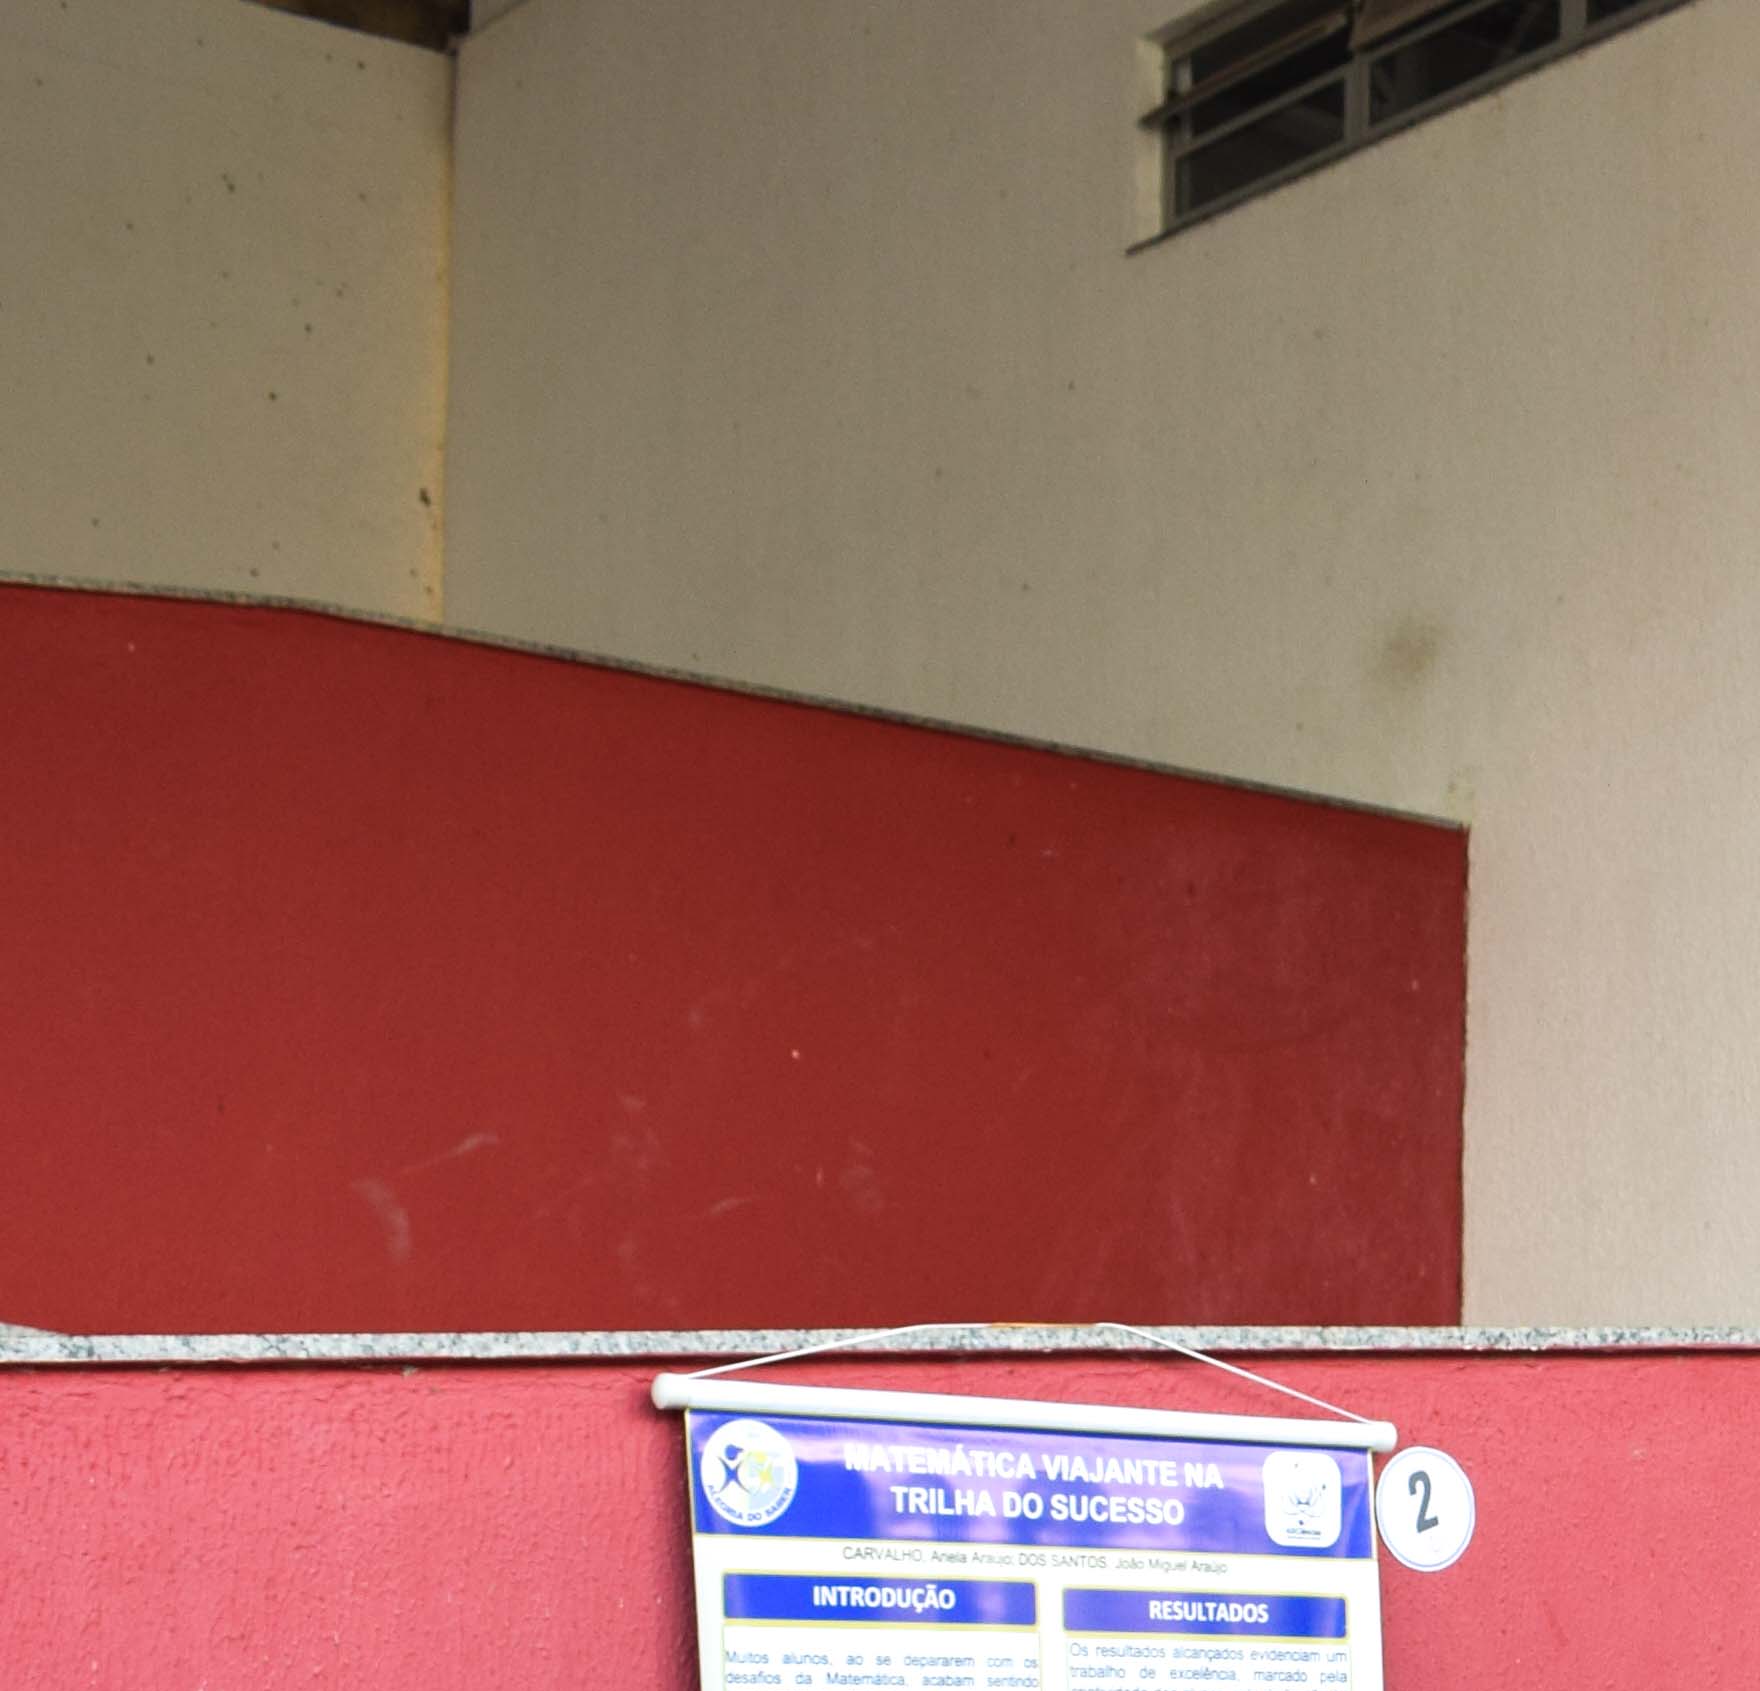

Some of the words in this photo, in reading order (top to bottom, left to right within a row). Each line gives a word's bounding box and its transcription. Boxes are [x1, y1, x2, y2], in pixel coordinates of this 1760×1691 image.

[844, 1441, 1036, 1479] MATEMÁTICA
[1041, 1454, 1179, 1488] VIAJANTE
[1185, 1463, 1225, 1489] NA
[890, 1486, 996, 1517] TRILHA
[1003, 1492, 1044, 1520] DO
[1050, 1496, 1185, 1526] SUCESSO
[1408, 1470, 1439, 1533] 2
[1019, 1552, 1046, 1566] DOS
[812, 1583, 956, 1612] INTRODUÇÃO
[1149, 1600, 1269, 1624] RESULTADOS
[725, 1650, 769, 1664] Muitos
[903, 1655, 975, 1668] depararem
[986, 1657, 1013, 1668] com
[1095, 1644, 1165, 1658] resultados
[1172, 1646, 1244, 1663] alcançados
[1249, 1648, 1320, 1662] evidenciam
[725, 1670, 782, 1684] desafios
[922, 1675, 974, 1686] acabam
[987, 1673, 1038, 1686] sentindo
[1069, 1664, 1126, 1678] trabalho
[1253, 1668, 1307, 1682] marcado
[1320, 1670, 1347, 1684] pela
